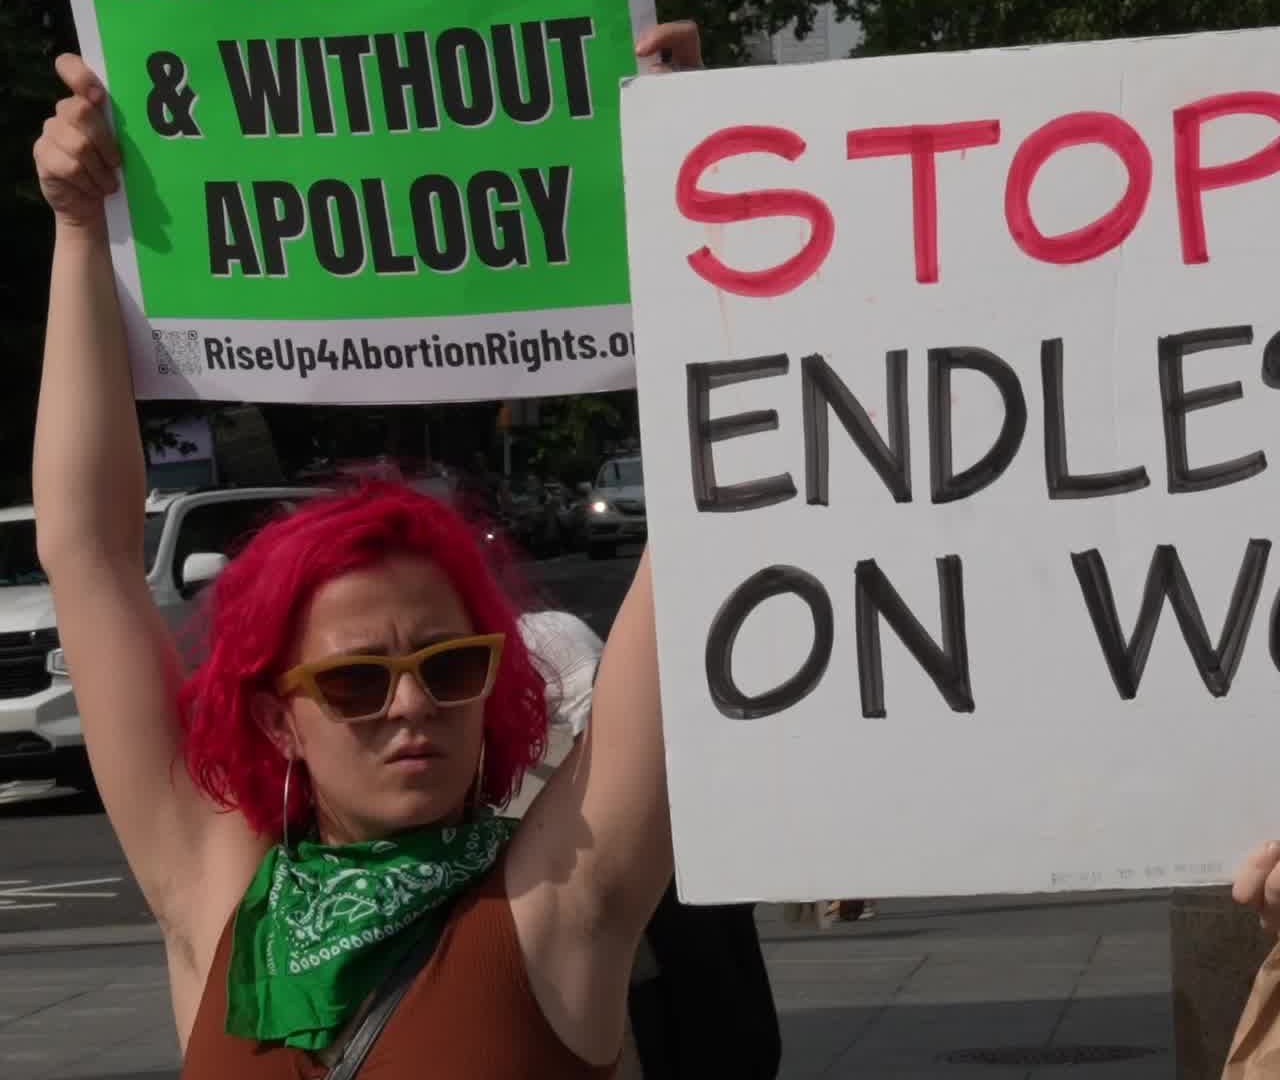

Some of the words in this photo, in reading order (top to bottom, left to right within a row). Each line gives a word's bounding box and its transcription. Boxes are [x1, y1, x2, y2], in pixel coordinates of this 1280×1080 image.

[146, 51, 202, 139] &
[217, 16, 594, 137] WITHOUT
[205, 165, 573, 277] APOLOGY
[204, 329, 635, 378] RiseUp4AbortionRights.o
[705, 554, 976, 721] ON
